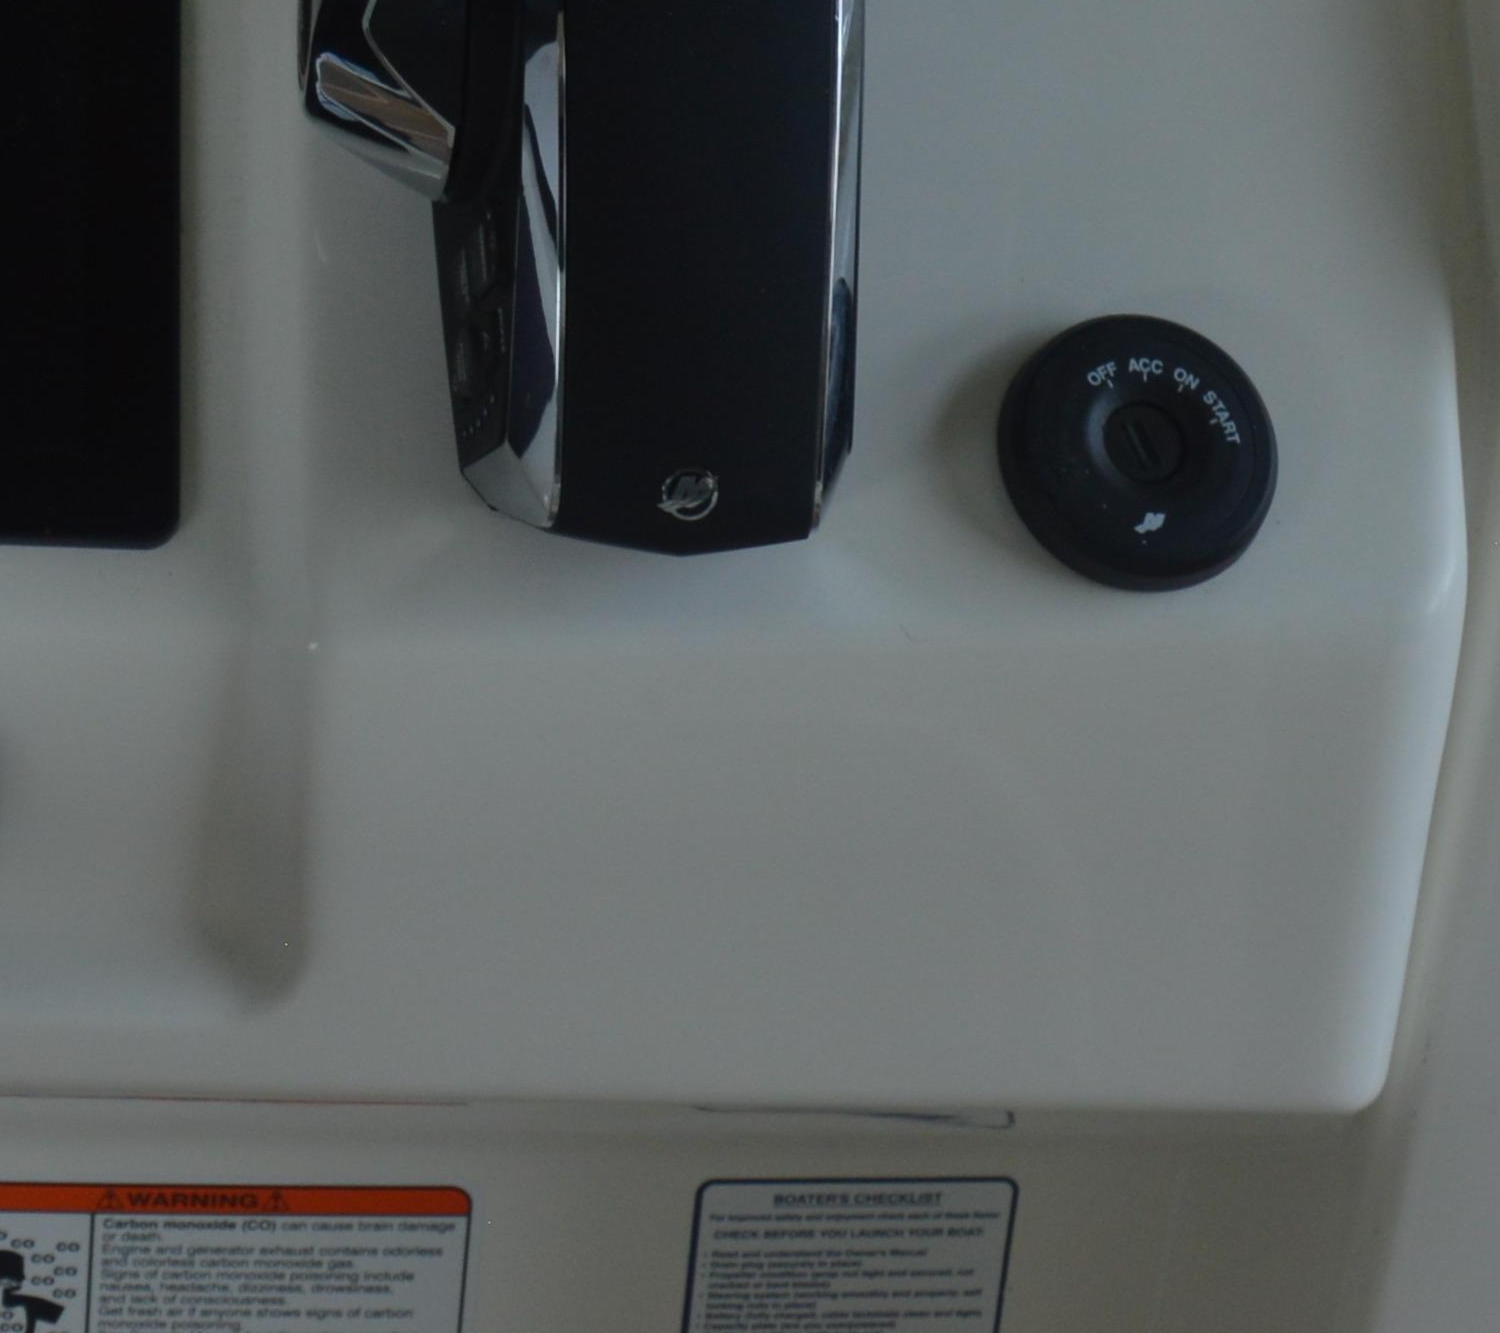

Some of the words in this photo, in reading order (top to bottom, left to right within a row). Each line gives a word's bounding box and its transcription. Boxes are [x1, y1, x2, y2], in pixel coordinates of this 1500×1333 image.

[1087, 361, 1118, 386] OFF
[1128, 358, 1163, 374] ACC
[1173, 368, 1199, 390] ON
[1203, 390, 1241, 445] START
[127, 1192, 259, 1210] WARNING
[774, 1193, 849, 1205] BOATER'S
[854, 1192, 942, 1205] CHECKLIST
[103, 1218, 158, 1230] Carbon
[163, 1219, 237, 1231] monoxide
[241, 1219, 277, 1234] (CO)
[281, 1221, 307, 1232] can
[311, 1222, 353, 1232] cause
[358, 1220, 393, 1232] brain
[397, 1221, 456, 1235] damage
[11, 1239, 35, 1249] CO
[57, 1242, 80, 1252] CO
[102, 1243, 150, 1257] Engine
[156, 1244, 182, 1254] and
[187, 1245, 254, 1258] generator
[259, 1245, 314, 1256] exhaust
[319, 1247, 378, 1257] contains
[382, 1247, 442, 1257] odorless
[31, 1254, 55, 1264] CO
[132, 1257, 195, 1268] colorless
[200, 1259, 248, 1269] carbon
[253, 1259, 323, 1269] monoxide
[54, 1266, 77, 1276] CO
[31, 1276, 54, 1286] CO
[162, 1270, 211, 1280] carbon
[216, 1270, 286, 1280] monoxide
[289, 1271, 359, 1284] poisoning
[363, 1271, 414, 1282] include
[53, 1288, 76, 1299] CO
[364, 1308, 414, 1319] carbon
[0, 1323, 24, 1333] CO
